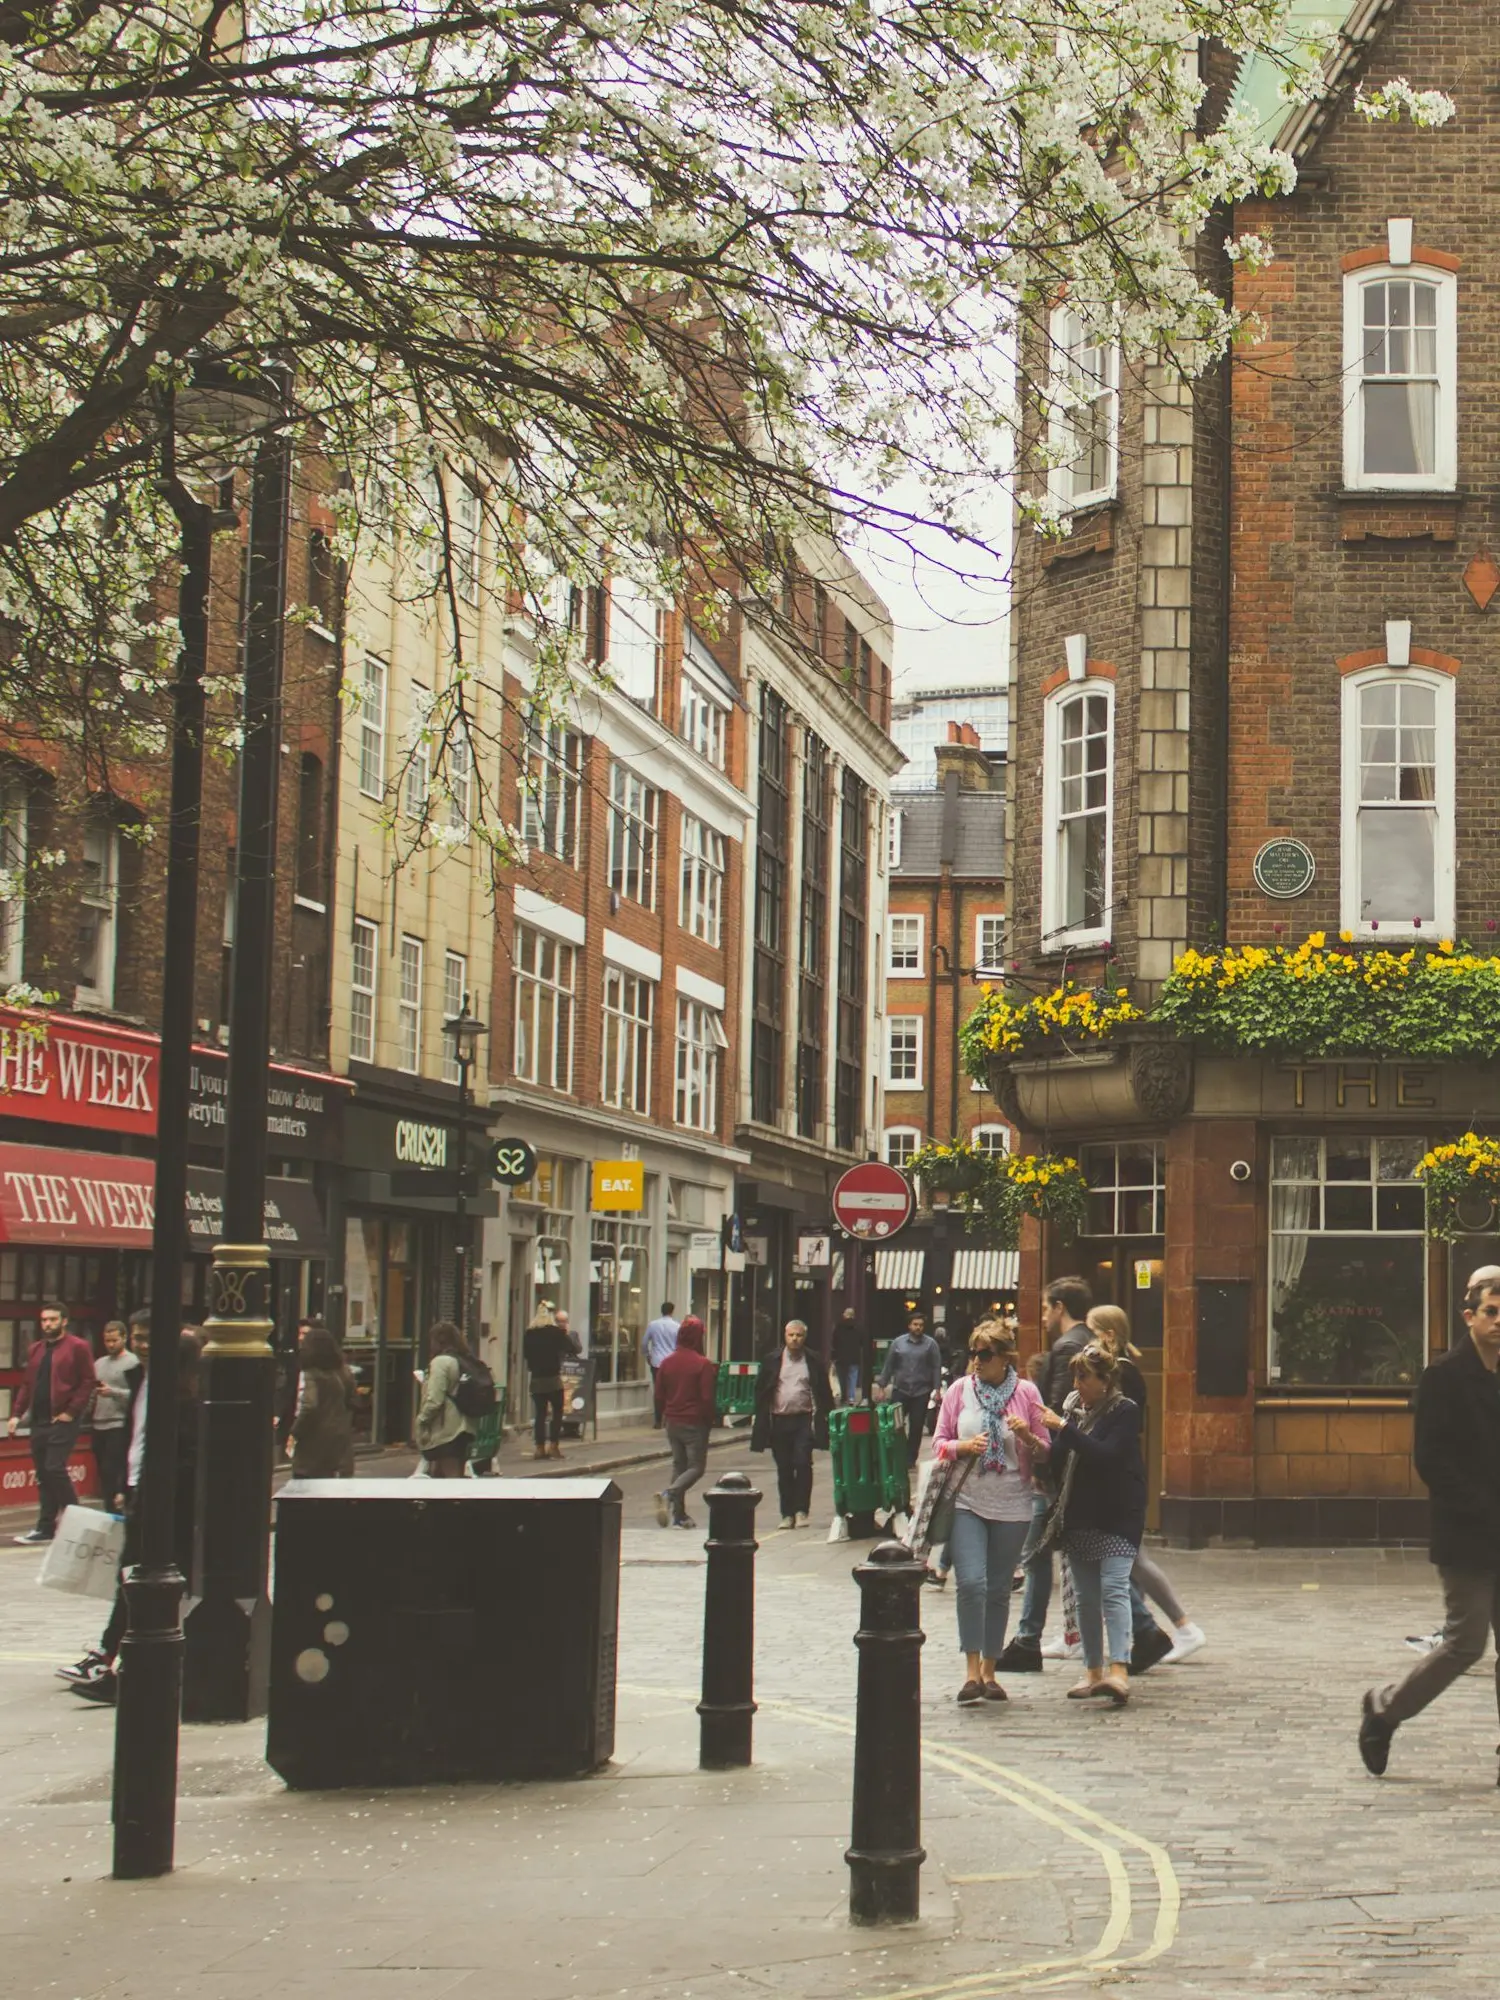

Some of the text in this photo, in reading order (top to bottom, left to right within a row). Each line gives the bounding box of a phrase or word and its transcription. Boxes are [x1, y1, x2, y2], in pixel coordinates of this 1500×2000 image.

[0, 1026, 153, 1112] HE WEEK
[1279, 1064, 1436, 1107] THE
[190, 1066, 198, 1090] ll
[199, 1074, 222, 1096] you
[295, 1088, 323, 1112] about
[267, 1115, 306, 1137] matters
[4, 1172, 155, 1230] THE WEEK
[601, 1178, 634, 1192] EAT.
[3, 1470, 27, 1489] 020
[63, 1539, 117, 1565] TOPS
